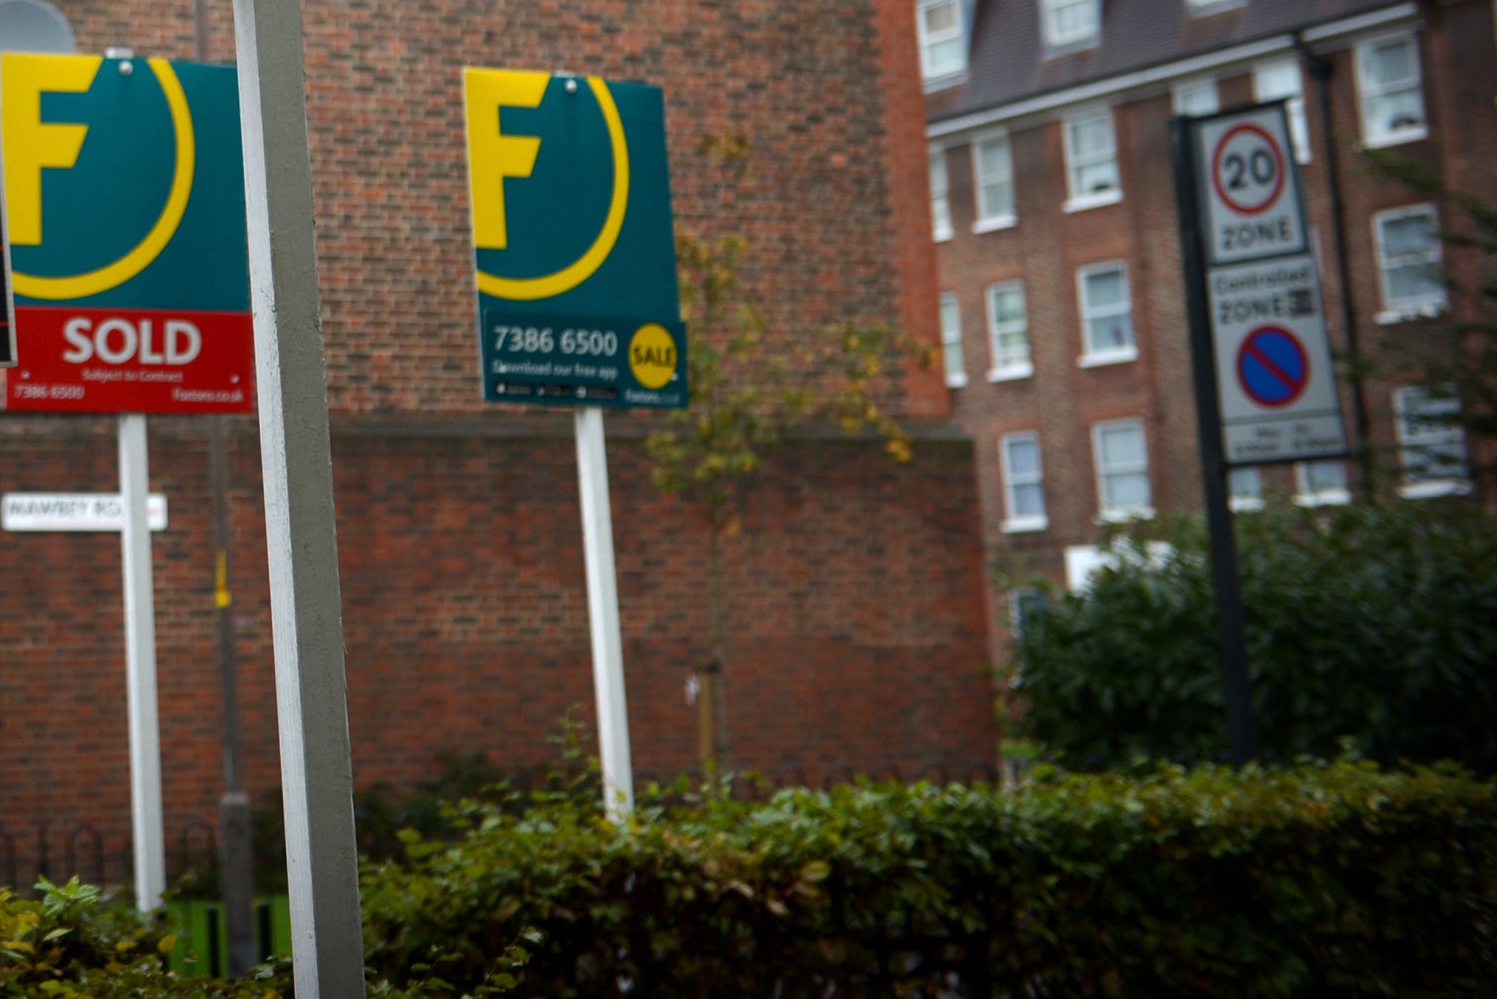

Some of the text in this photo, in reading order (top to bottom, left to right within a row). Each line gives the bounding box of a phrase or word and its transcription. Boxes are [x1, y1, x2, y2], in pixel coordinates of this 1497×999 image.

[1223, 148, 1275, 190] 20
[1221, 217, 1293, 251] ZONE
[1219, 293, 1284, 325] ZONE
[63, 317, 202, 365] SOLD
[494, 325, 618, 357] 7386 6500
[633, 345, 676, 367] SALE
[554, 363, 572, 375] our
[575, 362, 596, 377] free
[598, 366, 618, 382] app
